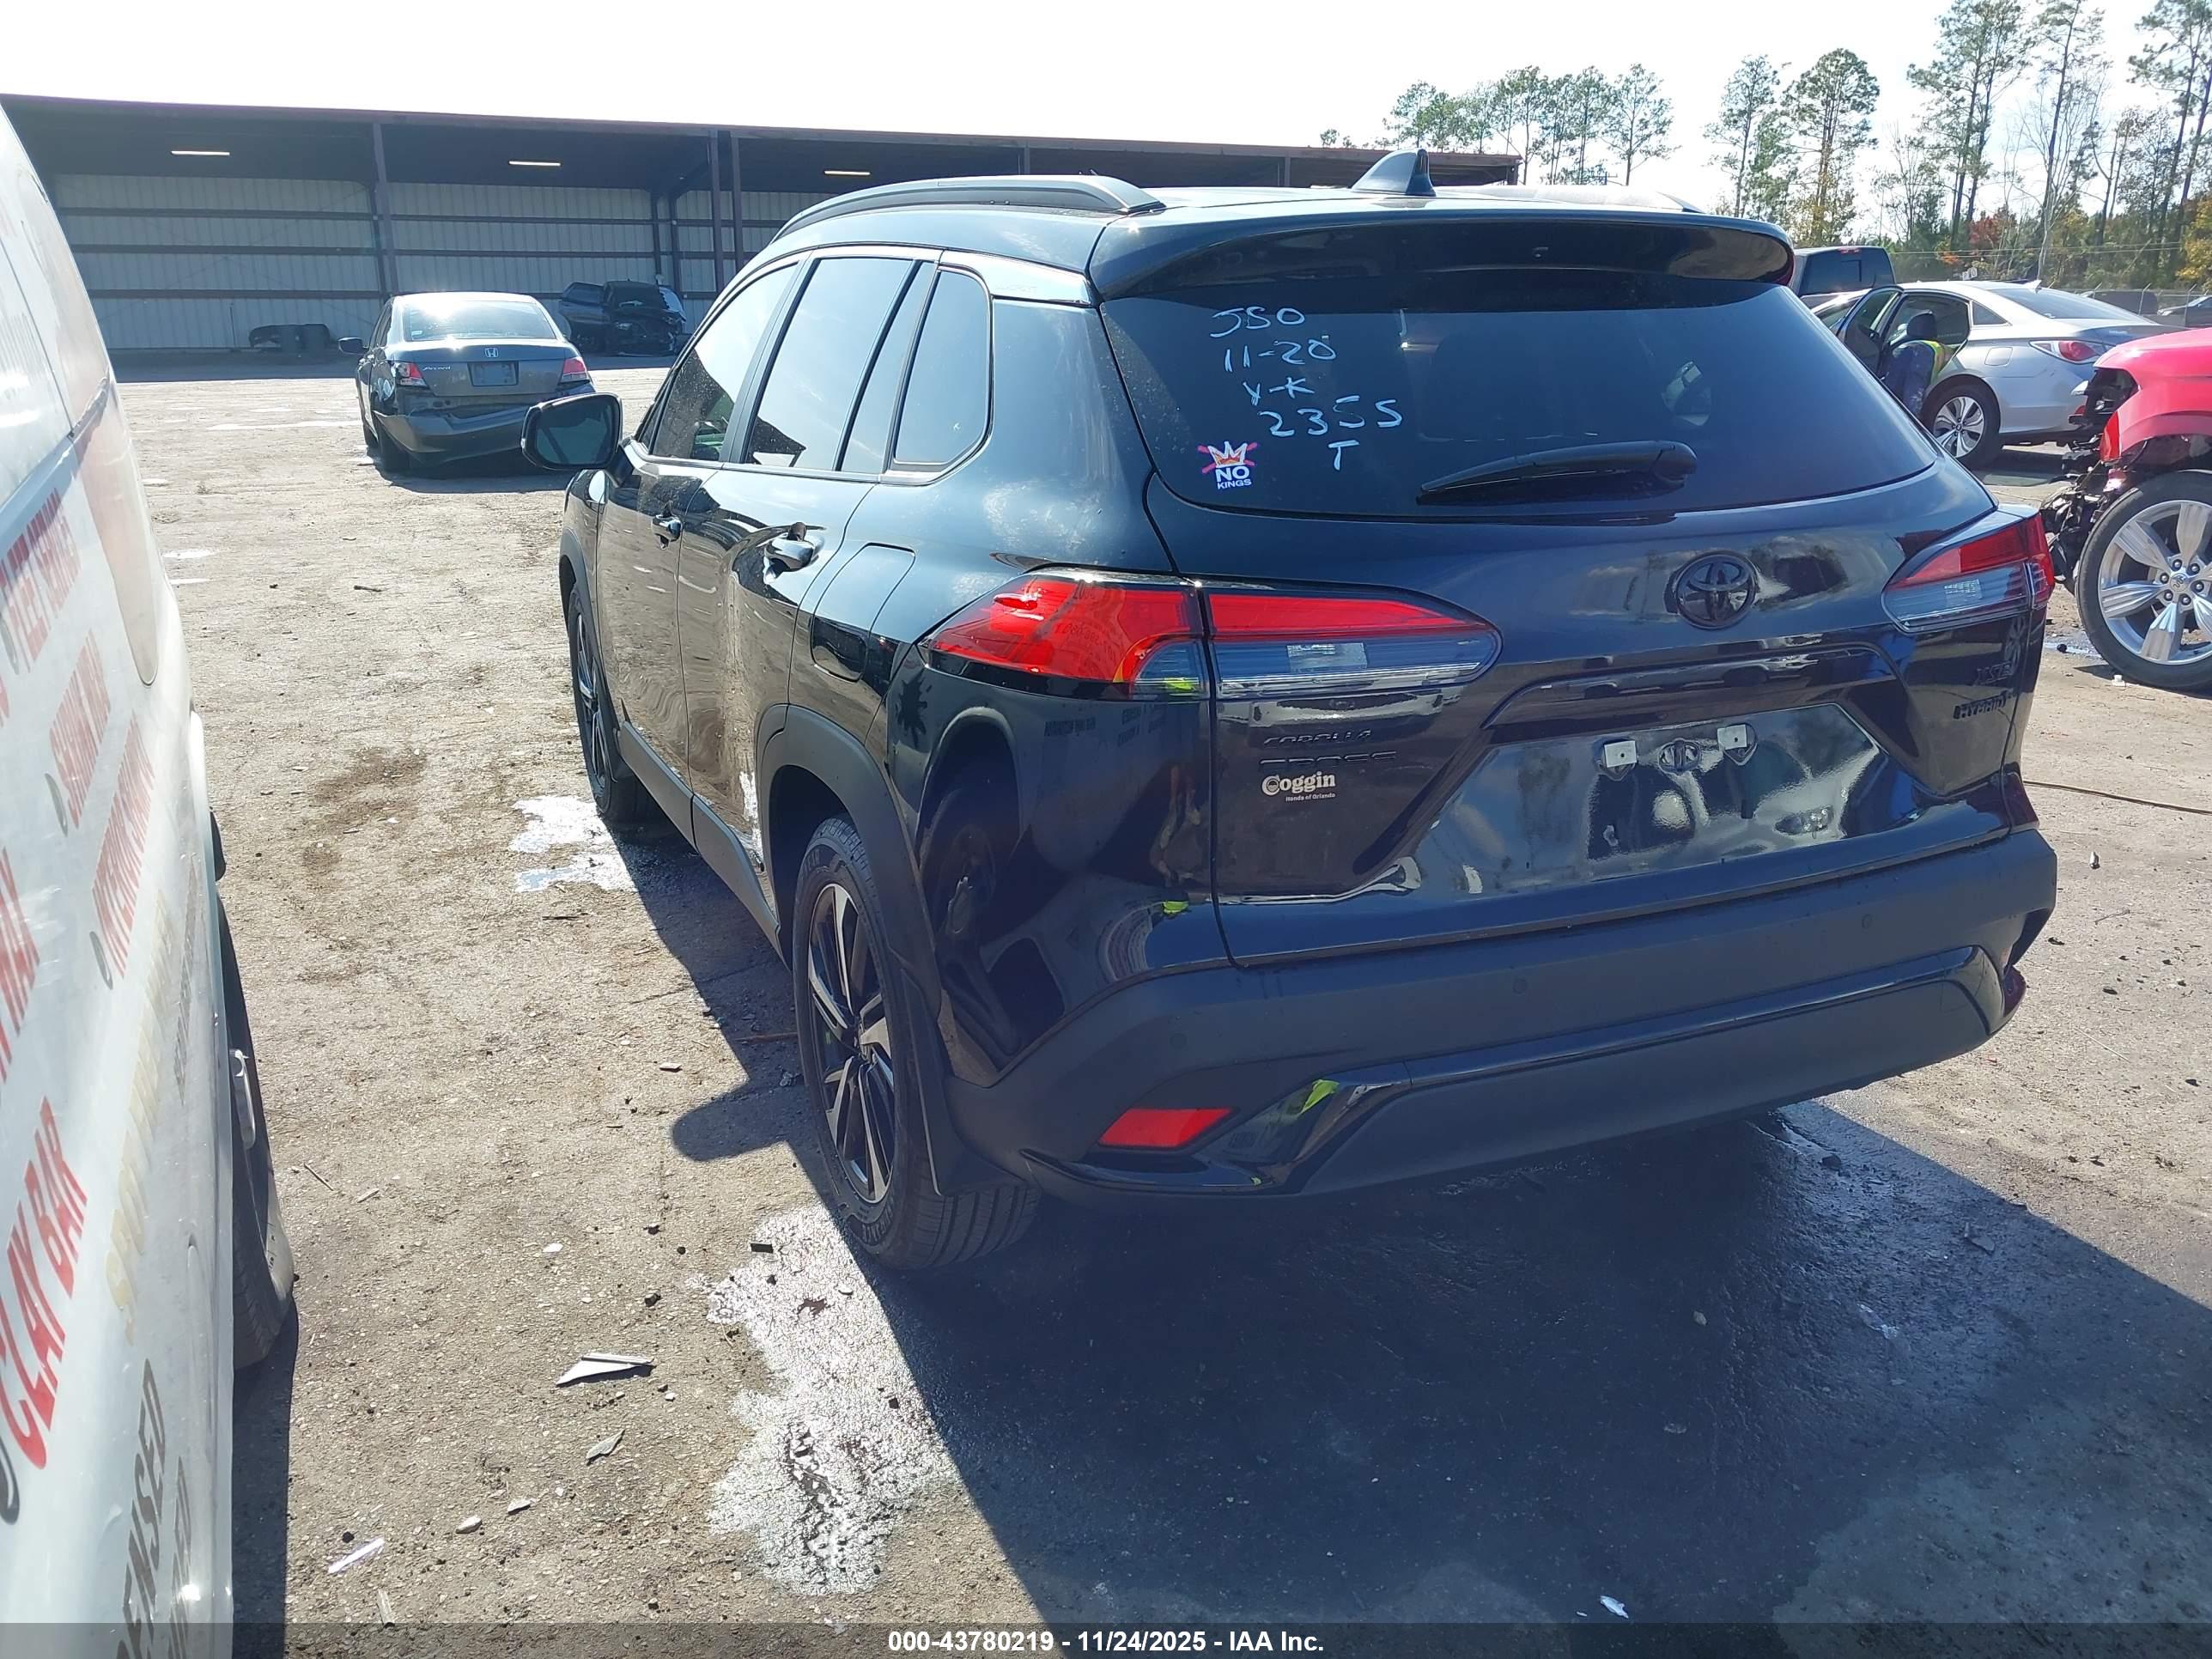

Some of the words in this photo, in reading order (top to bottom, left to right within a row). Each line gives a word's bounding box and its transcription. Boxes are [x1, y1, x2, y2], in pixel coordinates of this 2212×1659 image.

[1224, 336, 1336, 373] 11-20
[1328, 439, 1360, 471] T
[1215, 465, 1250, 483] NO
[1217, 478, 1252, 489] KINGS
[1263, 730, 1371, 749] COROLLA
[1261, 771, 1336, 796] Coggin
[24, 1095, 88, 1298] BAR
[0, 1200, 65, 1470] CLAY
